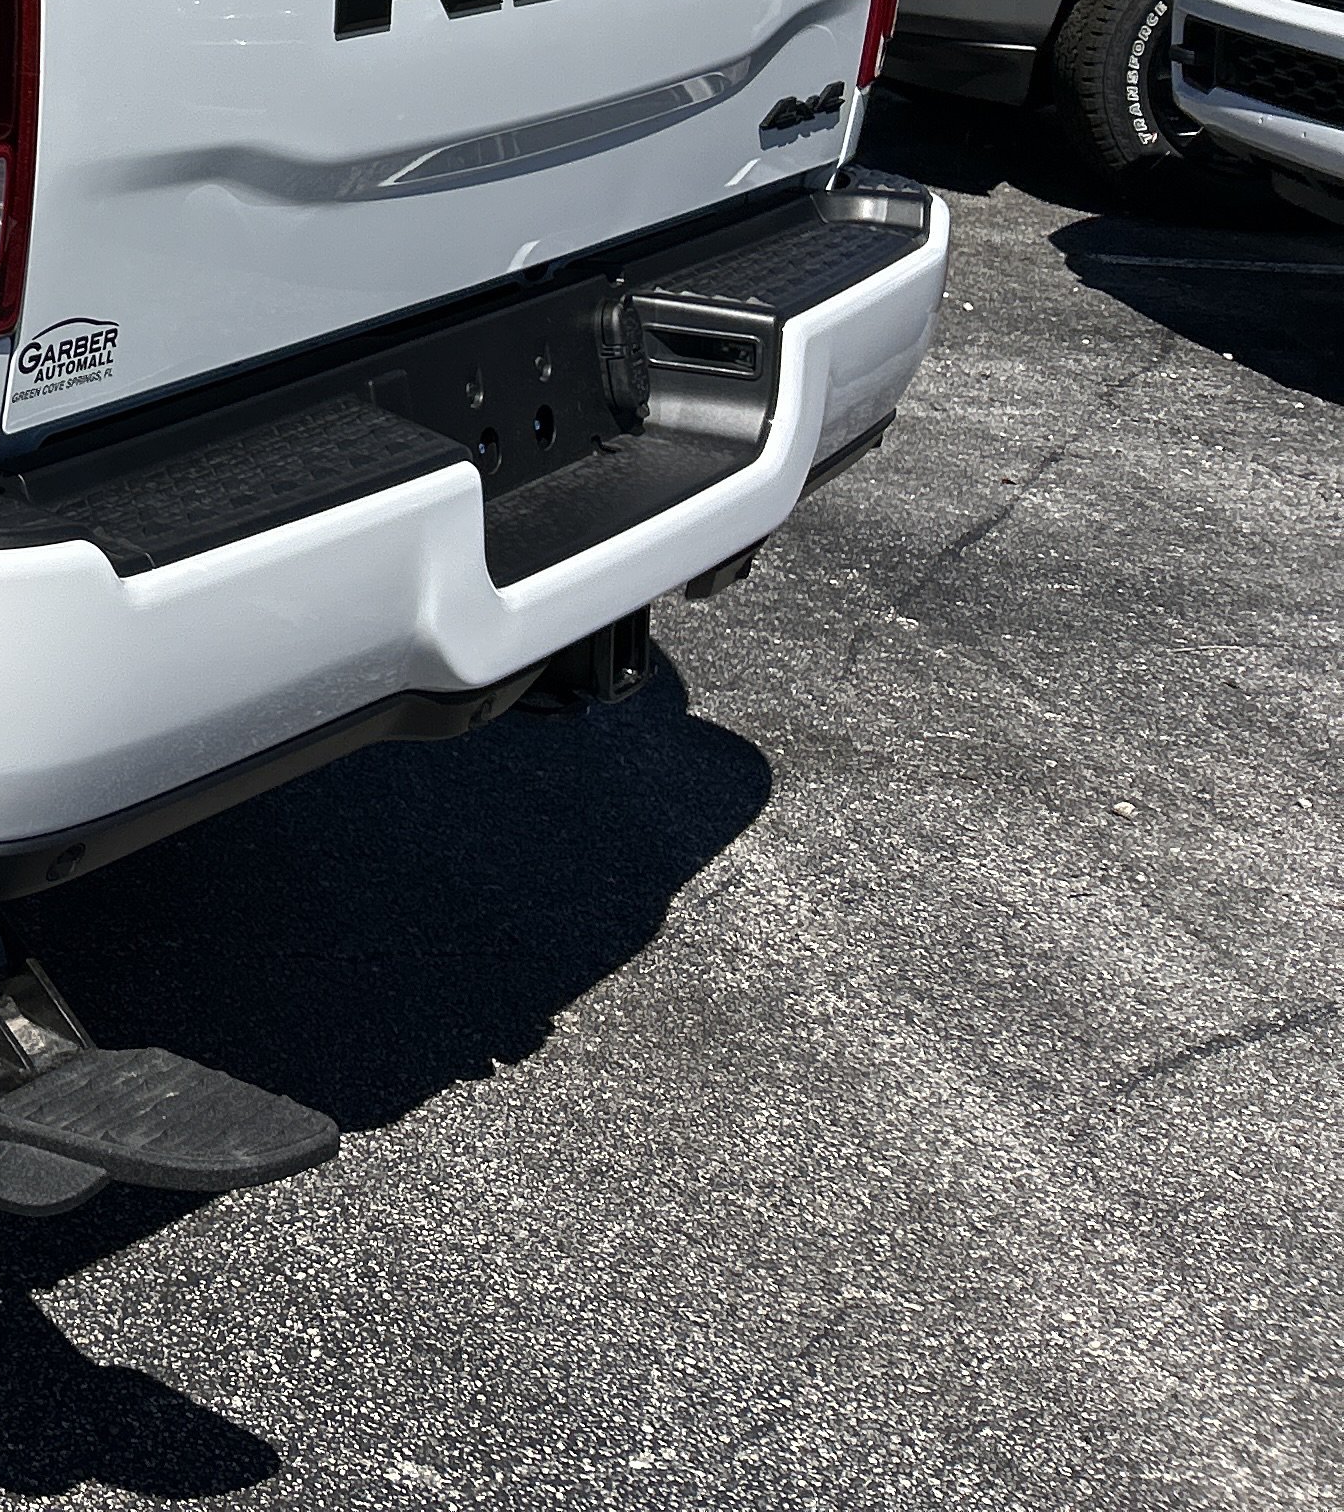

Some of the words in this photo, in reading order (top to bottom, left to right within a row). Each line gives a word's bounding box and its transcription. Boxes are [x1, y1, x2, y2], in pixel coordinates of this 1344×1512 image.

[1126, 0, 1168, 145] TRANSFORCE
[18, 327, 118, 375] GARBER
[34, 350, 114, 384] AUTOMALL
[12, 387, 42, 403] GREEN
[42, 380, 66, 395] COVE
[104, 368, 113, 379] FL
